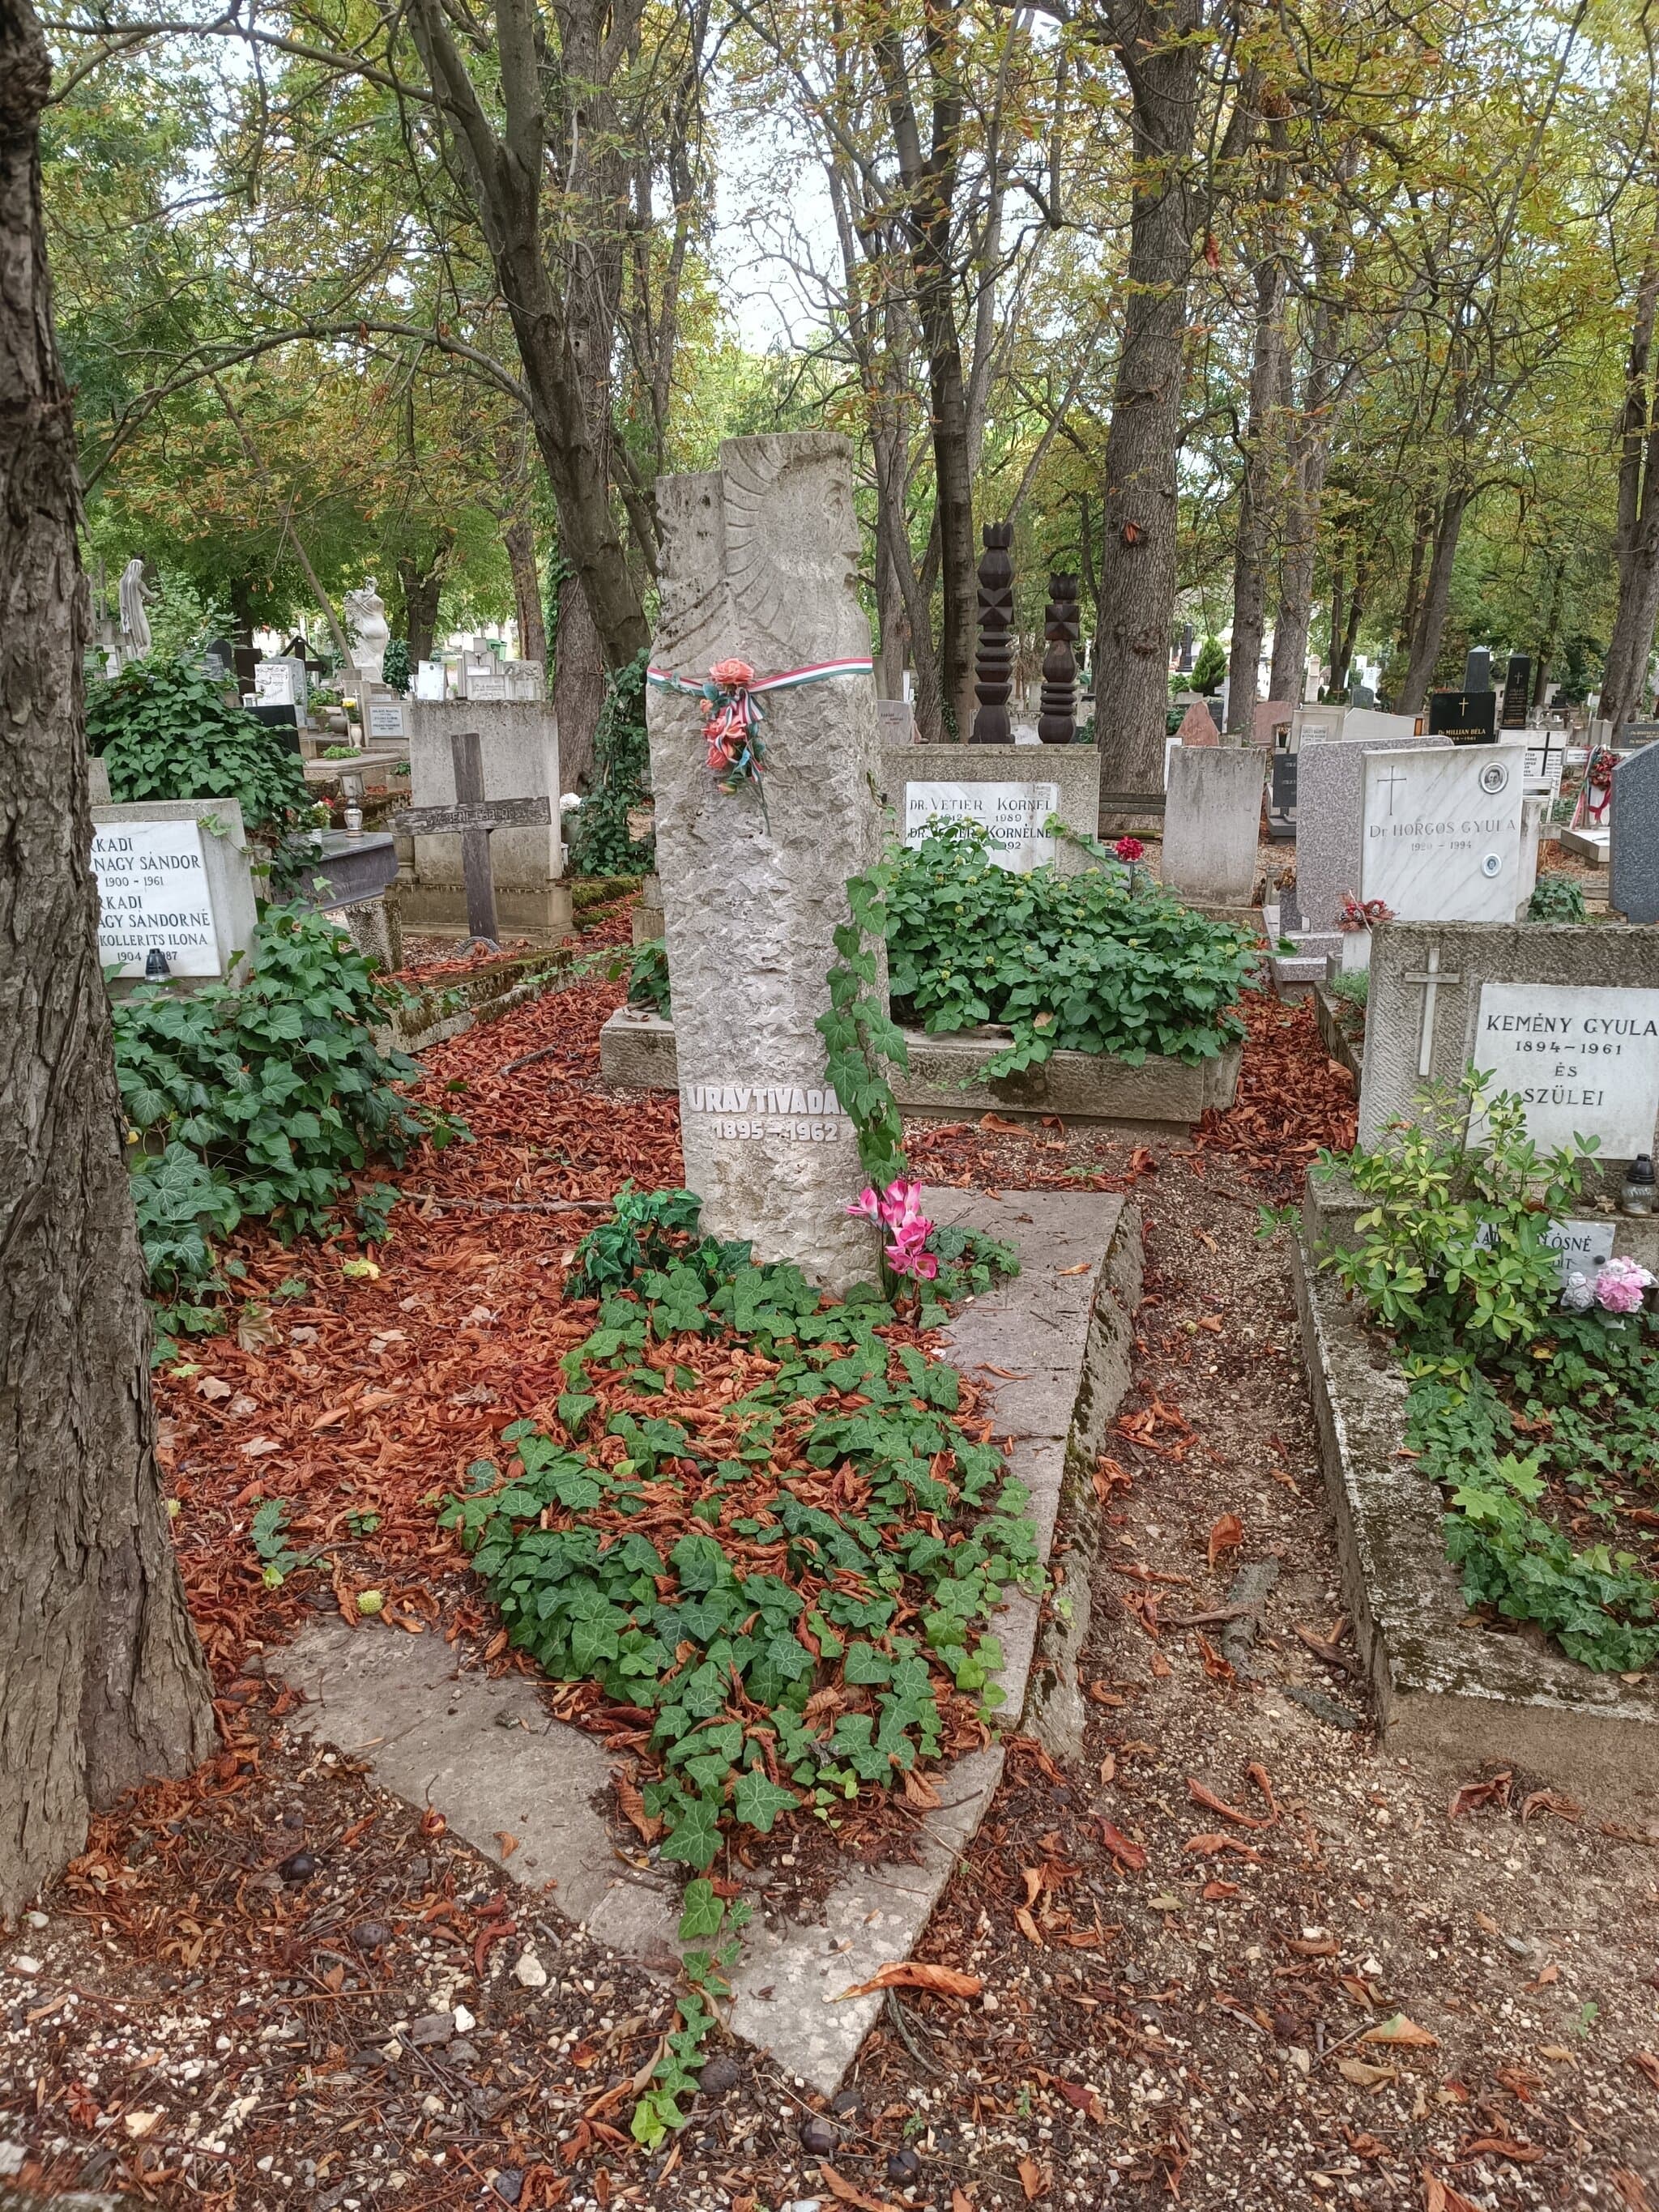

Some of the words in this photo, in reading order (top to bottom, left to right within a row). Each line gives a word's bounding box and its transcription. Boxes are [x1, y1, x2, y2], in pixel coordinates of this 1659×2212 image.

[910, 799, 928, 811] DR.
[996, 813, 1022, 822] 1989
[1450, 840, 1472, 850] 1994
[94, 856, 135, 872] NAGY
[140, 851, 201, 871] SÁNDOR
[104, 876, 130, 888] 1900
[143, 876, 164, 887] 1961
[129, 908, 211, 928] SÁNDORNÉ
[100, 934, 165, 947] KOLLERITS
[168, 933, 208, 946] ILONA
[117, 951, 142, 961] 1904
[1486, 1012, 1572, 1034] KEMÉNY
[1583, 1017, 1657, 1037] GYULA
[1555, 1062, 1578, 1077] ÉS
[688, 1086, 752, 1113] URAY
[753, 1087, 850, 1116] TIVADA
[1522, 1085, 1604, 1106] SZÜLEI
